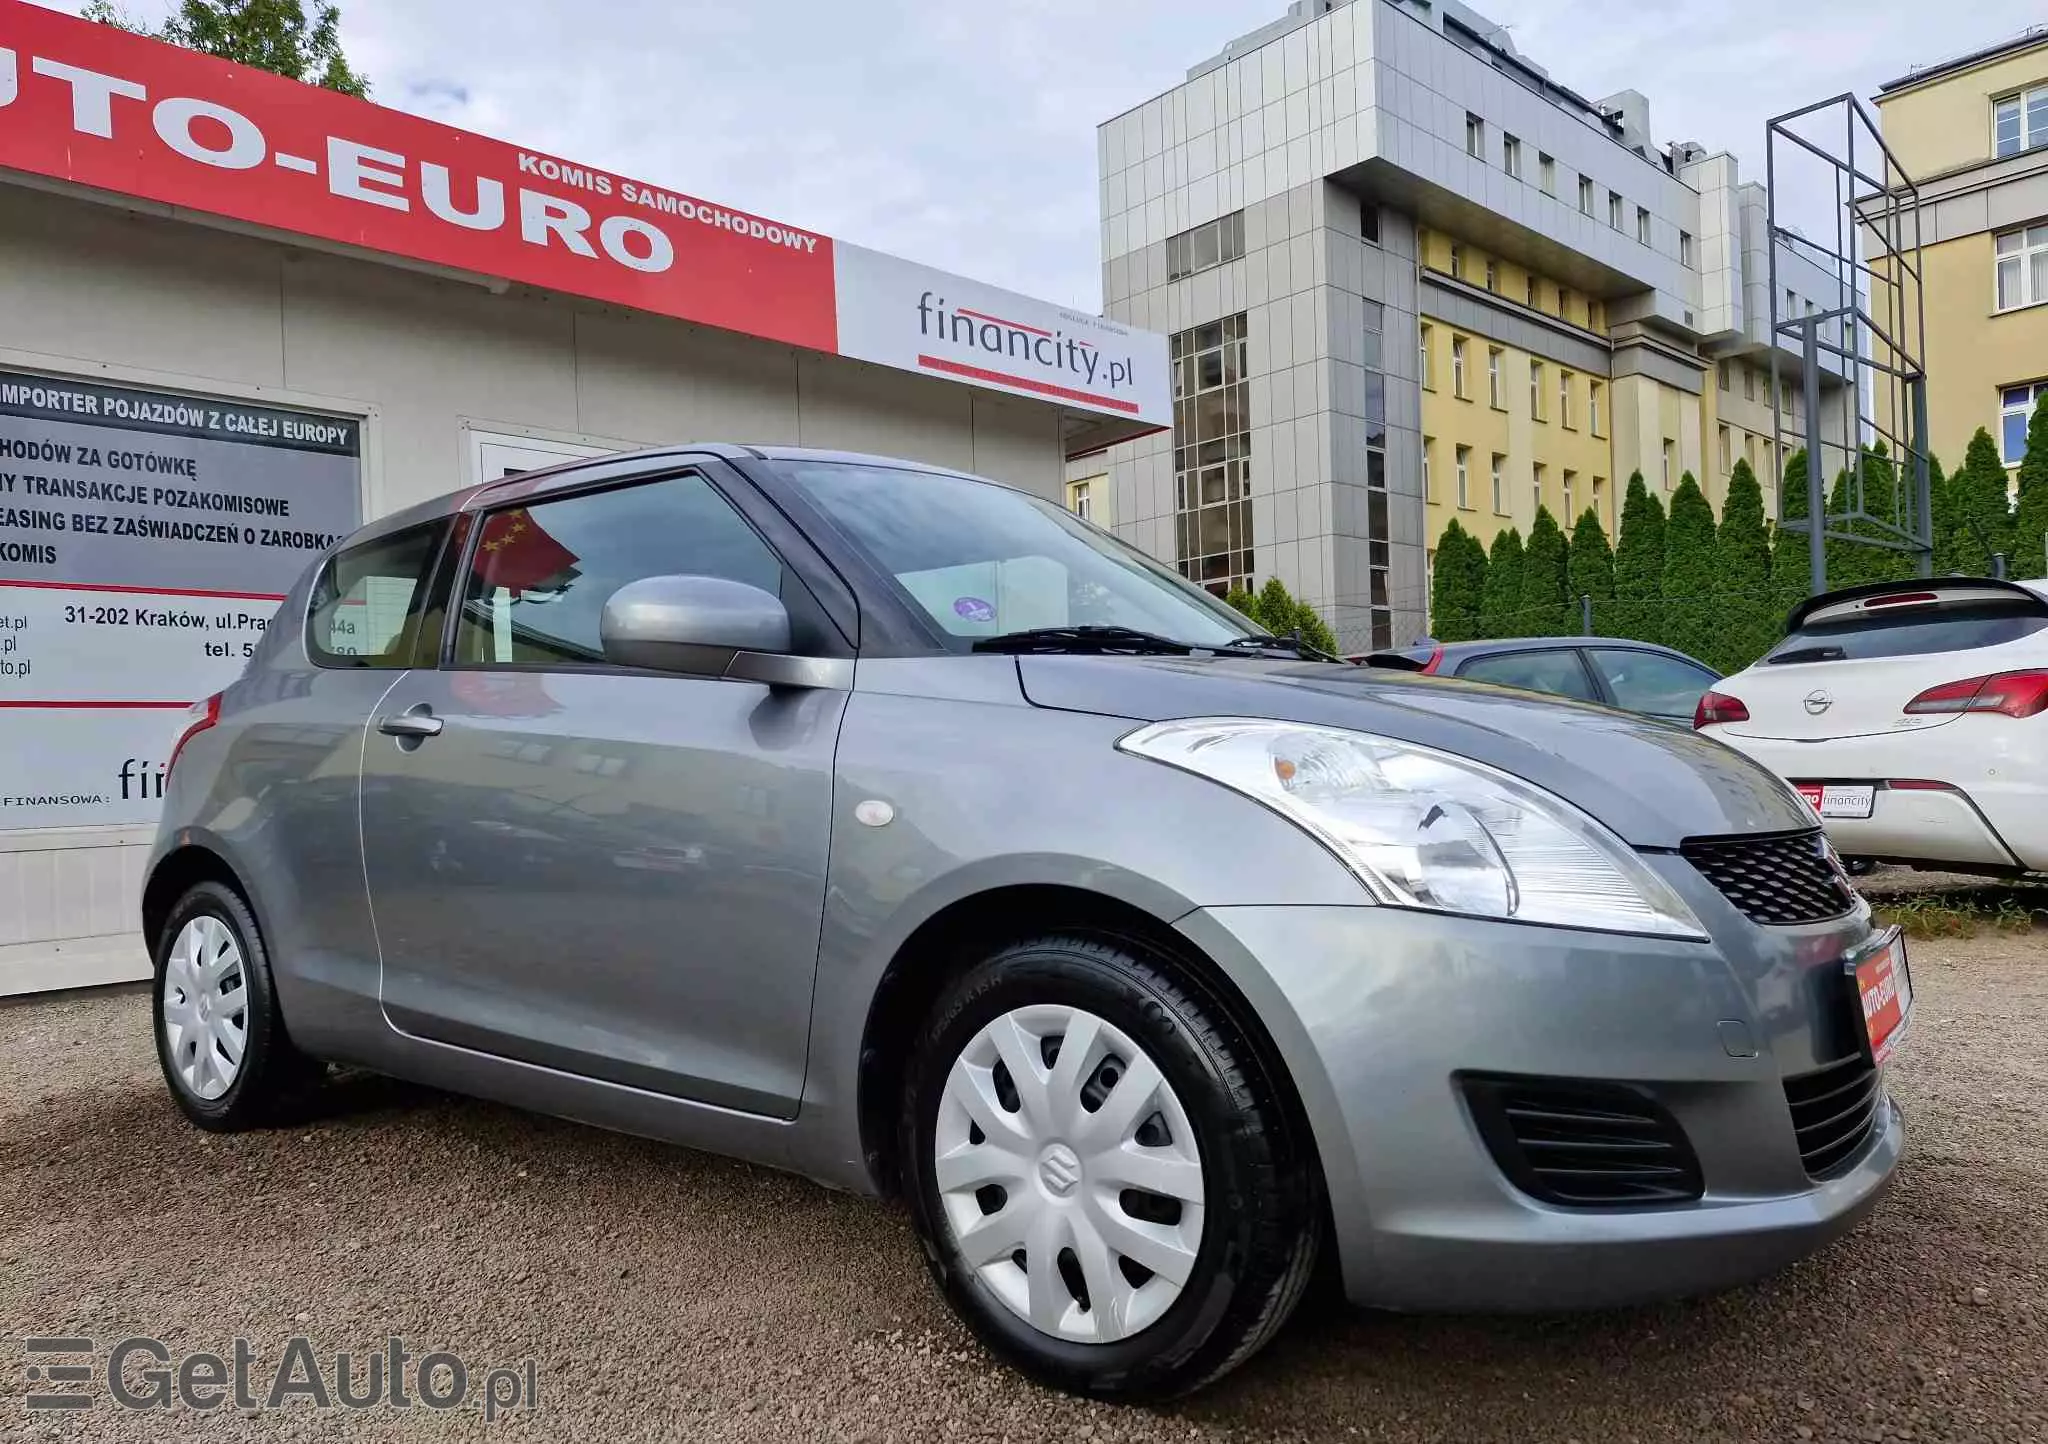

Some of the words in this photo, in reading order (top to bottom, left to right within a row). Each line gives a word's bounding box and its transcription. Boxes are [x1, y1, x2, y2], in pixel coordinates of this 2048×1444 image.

[0, 46, 674, 273] TO-EURO
[518, 152, 612, 195] KOMIS
[621, 183, 817, 253] SAMOCHODOWY
[917, 291, 1133, 388] financity.pl
[0, 383, 99, 415] MPORTER
[103, 397, 204, 427] POJAZDÓW
[209, 411, 221, 430] Z
[225, 413, 277, 437] CAŁEJ
[283, 420, 348, 445] EUROPY
[77, 447, 102, 467] ZA
[107, 450, 197, 481] GOTÓWKĘ
[23, 475, 148, 505] TRANSAKCJE
[154, 487, 289, 517] POZAKOMISOWE
[72, 513, 109, 535] BEZ
[113, 515, 239, 544] ZAŚWIADCZEŃ
[244, 527, 256, 545] O
[260, 529, 343, 551] ZAROBKA
[64, 605, 129, 626] 31-202
[135, 608, 209, 631] Kraków,
[204, 642, 235, 657] tel.
